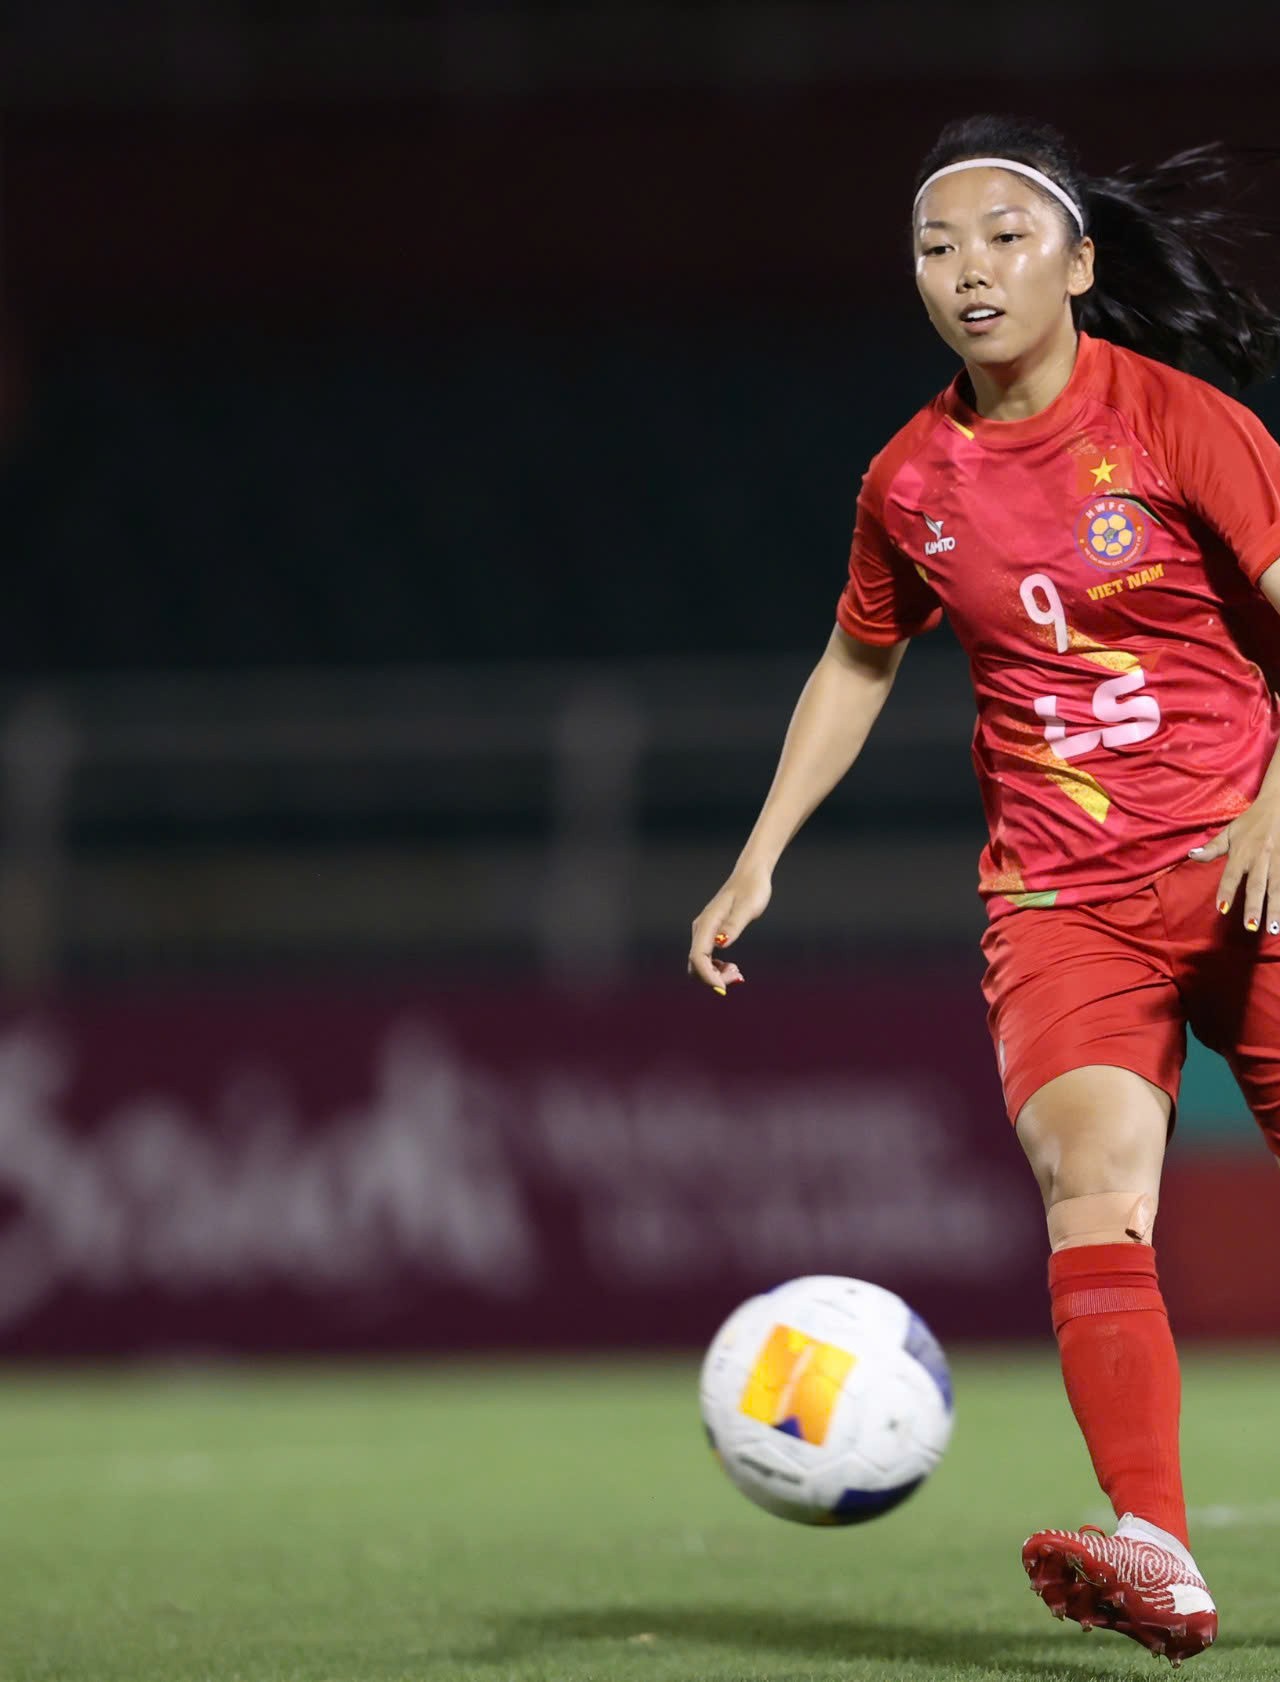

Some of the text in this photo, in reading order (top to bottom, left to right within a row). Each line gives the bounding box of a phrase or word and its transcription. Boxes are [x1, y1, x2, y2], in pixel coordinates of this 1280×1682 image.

[1087, 563, 1165, 601] VIET NAM
[1019, 573, 1069, 654] 9
